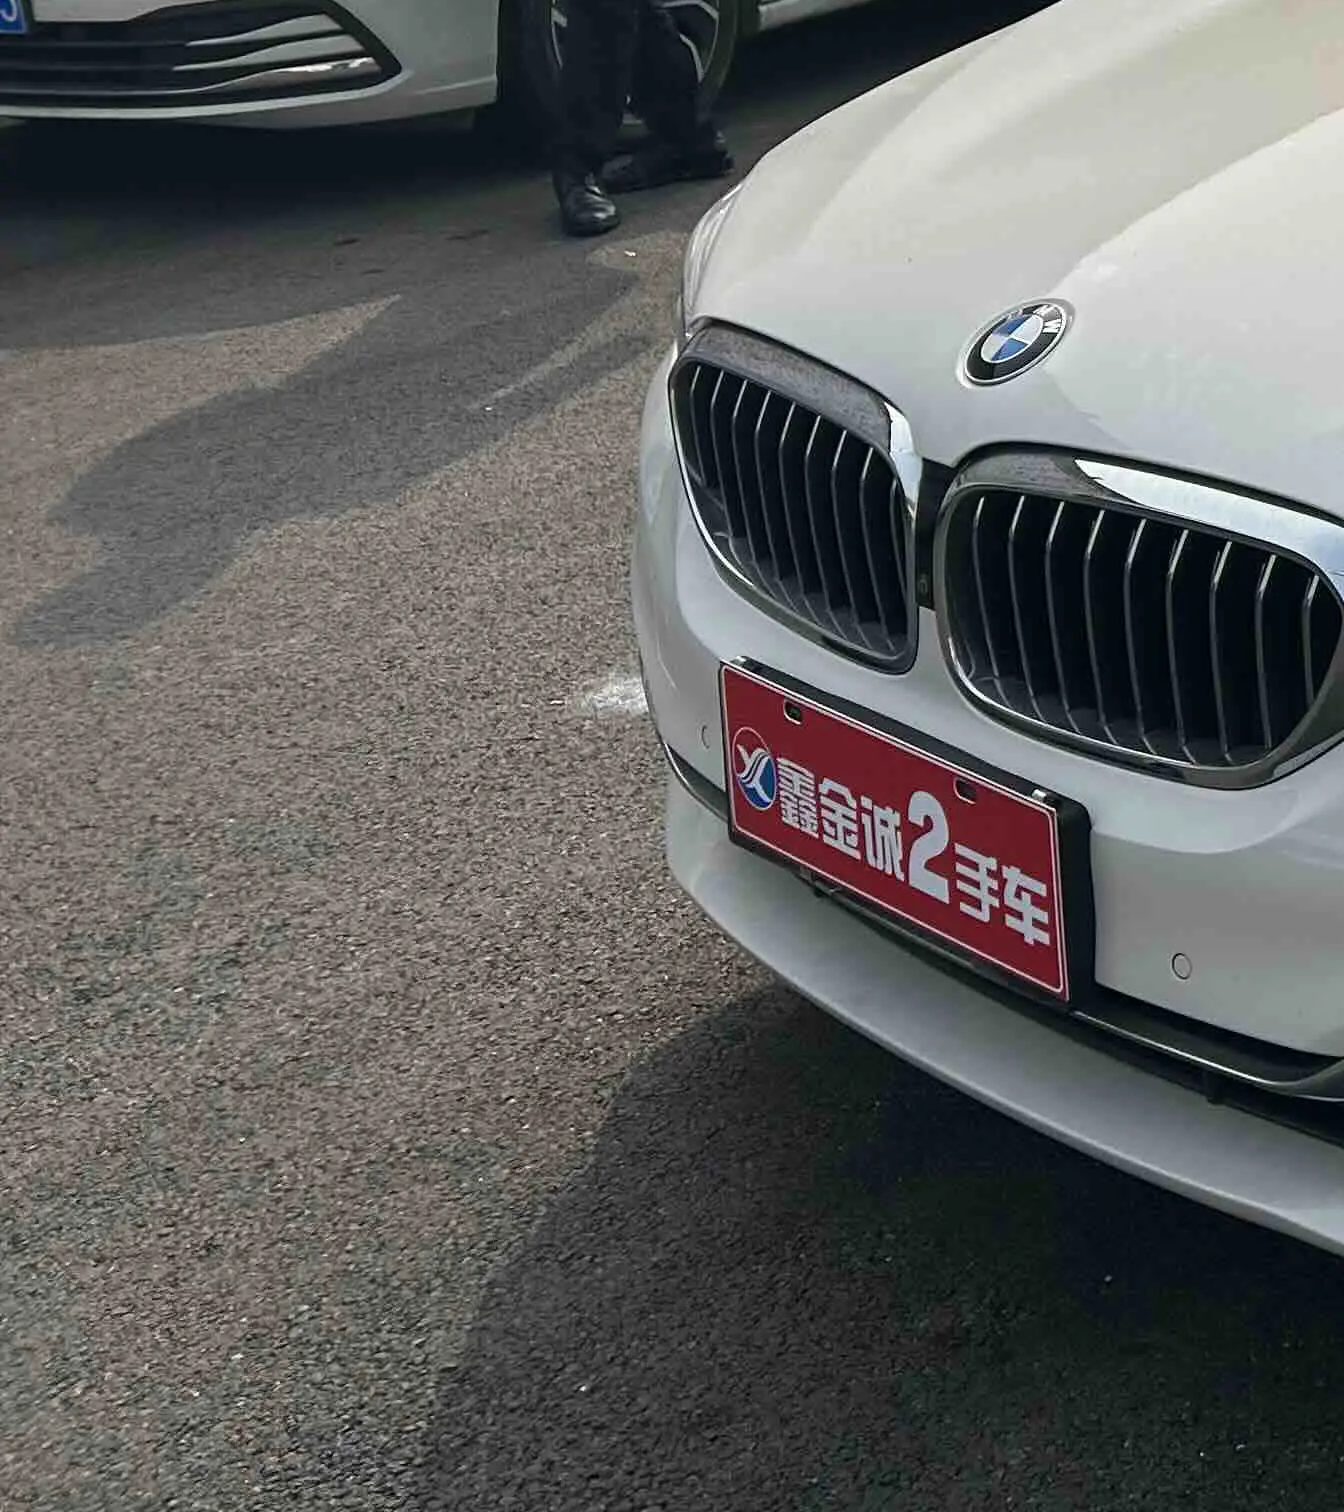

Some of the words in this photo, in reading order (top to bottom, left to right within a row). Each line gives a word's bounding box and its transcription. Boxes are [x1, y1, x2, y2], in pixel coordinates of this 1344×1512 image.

[776, 756, 1051, 946] 鑫金诚2手车
